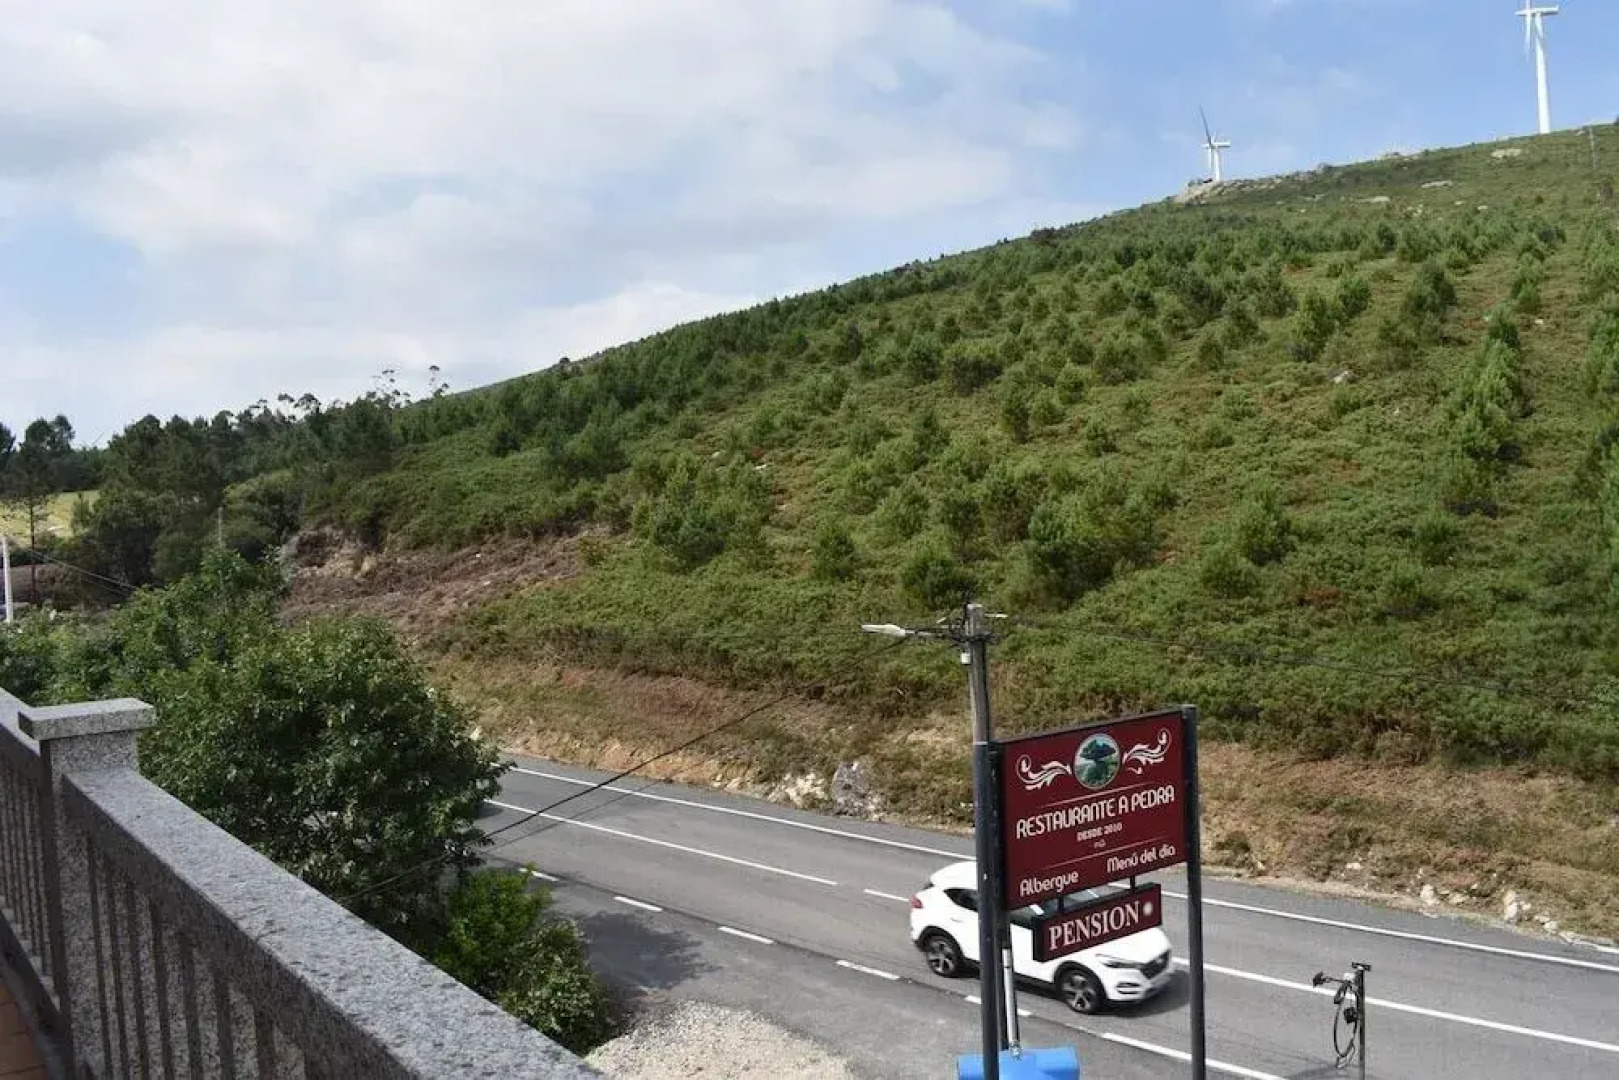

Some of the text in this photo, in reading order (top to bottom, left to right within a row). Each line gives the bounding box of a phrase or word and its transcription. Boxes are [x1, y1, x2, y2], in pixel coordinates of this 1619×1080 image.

[1016, 784, 1175, 839] RESTAURANTE A PEDRA
[1140, 847, 1157, 864] del
[1019, 871, 1079, 898] Albergue
[1049, 901, 1141, 950] PENSION
